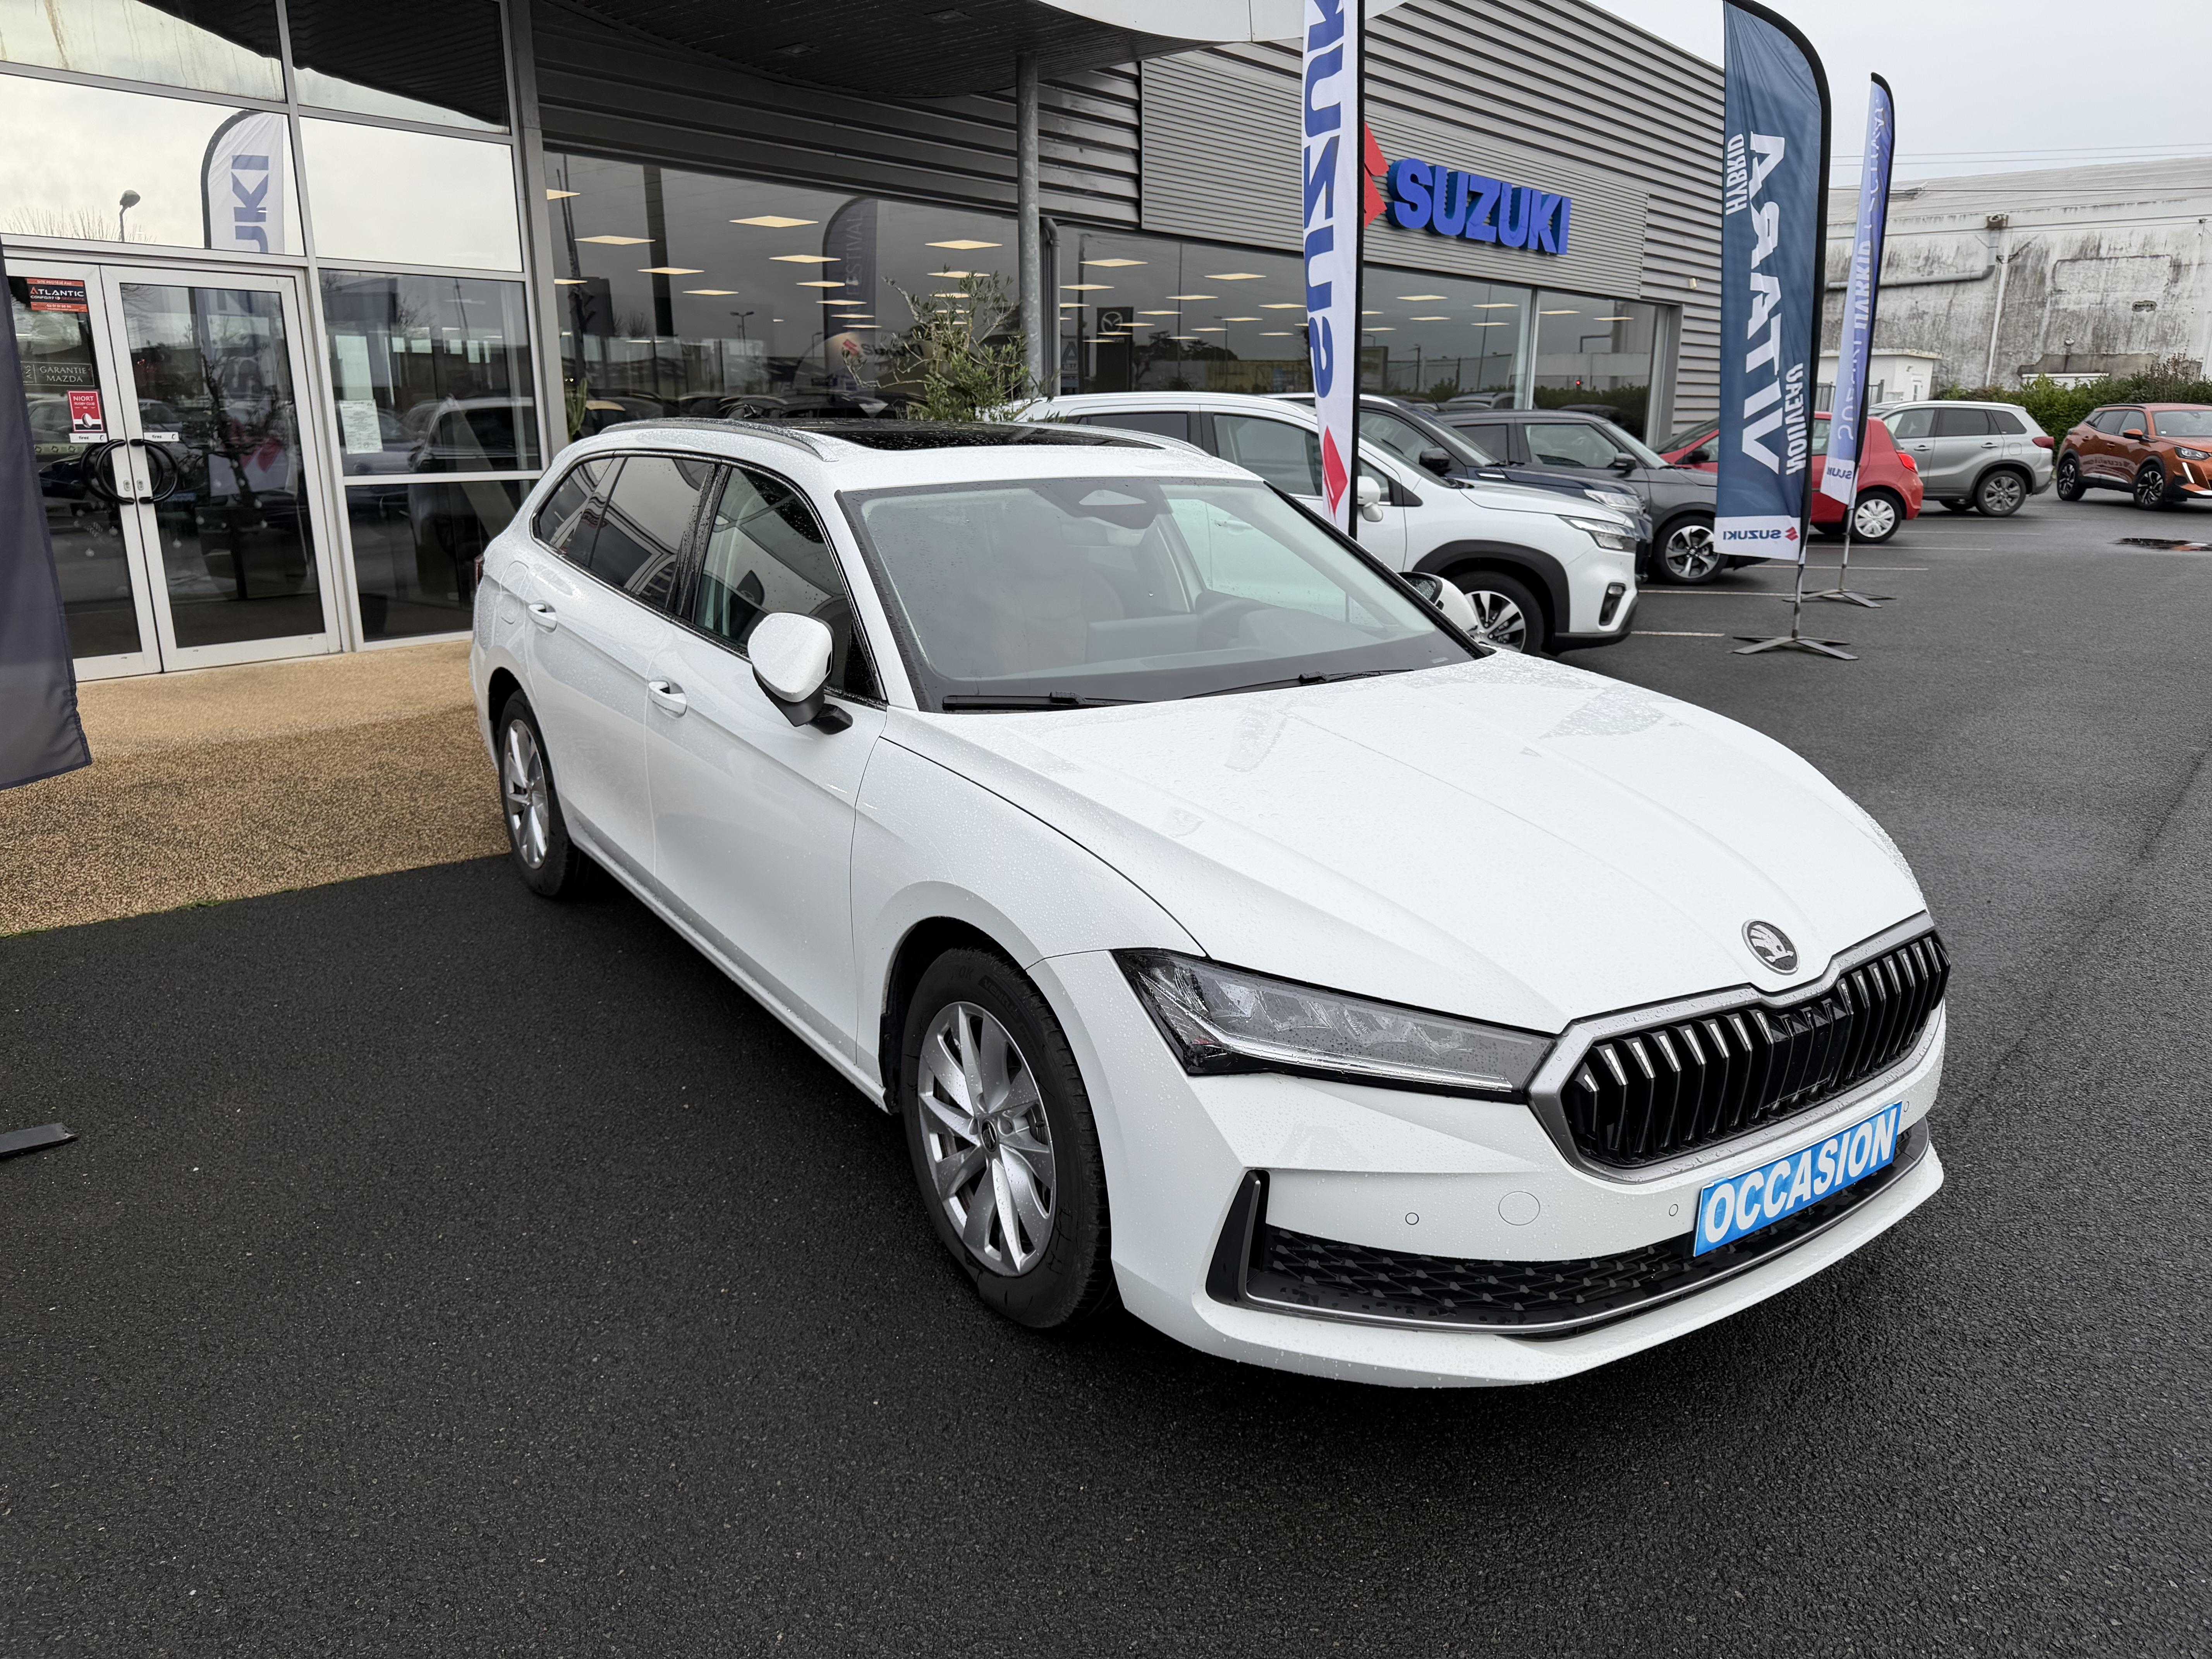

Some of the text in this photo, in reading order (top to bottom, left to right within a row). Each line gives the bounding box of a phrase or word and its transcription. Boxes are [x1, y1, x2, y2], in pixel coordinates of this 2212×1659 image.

[1387, 158, 1571, 255] SUZUKI
[30, 286, 84, 297] ATLANTIC
[40, 366, 87, 374] GARANTIE
[1705, 1108, 1898, 1243] OCCASION
